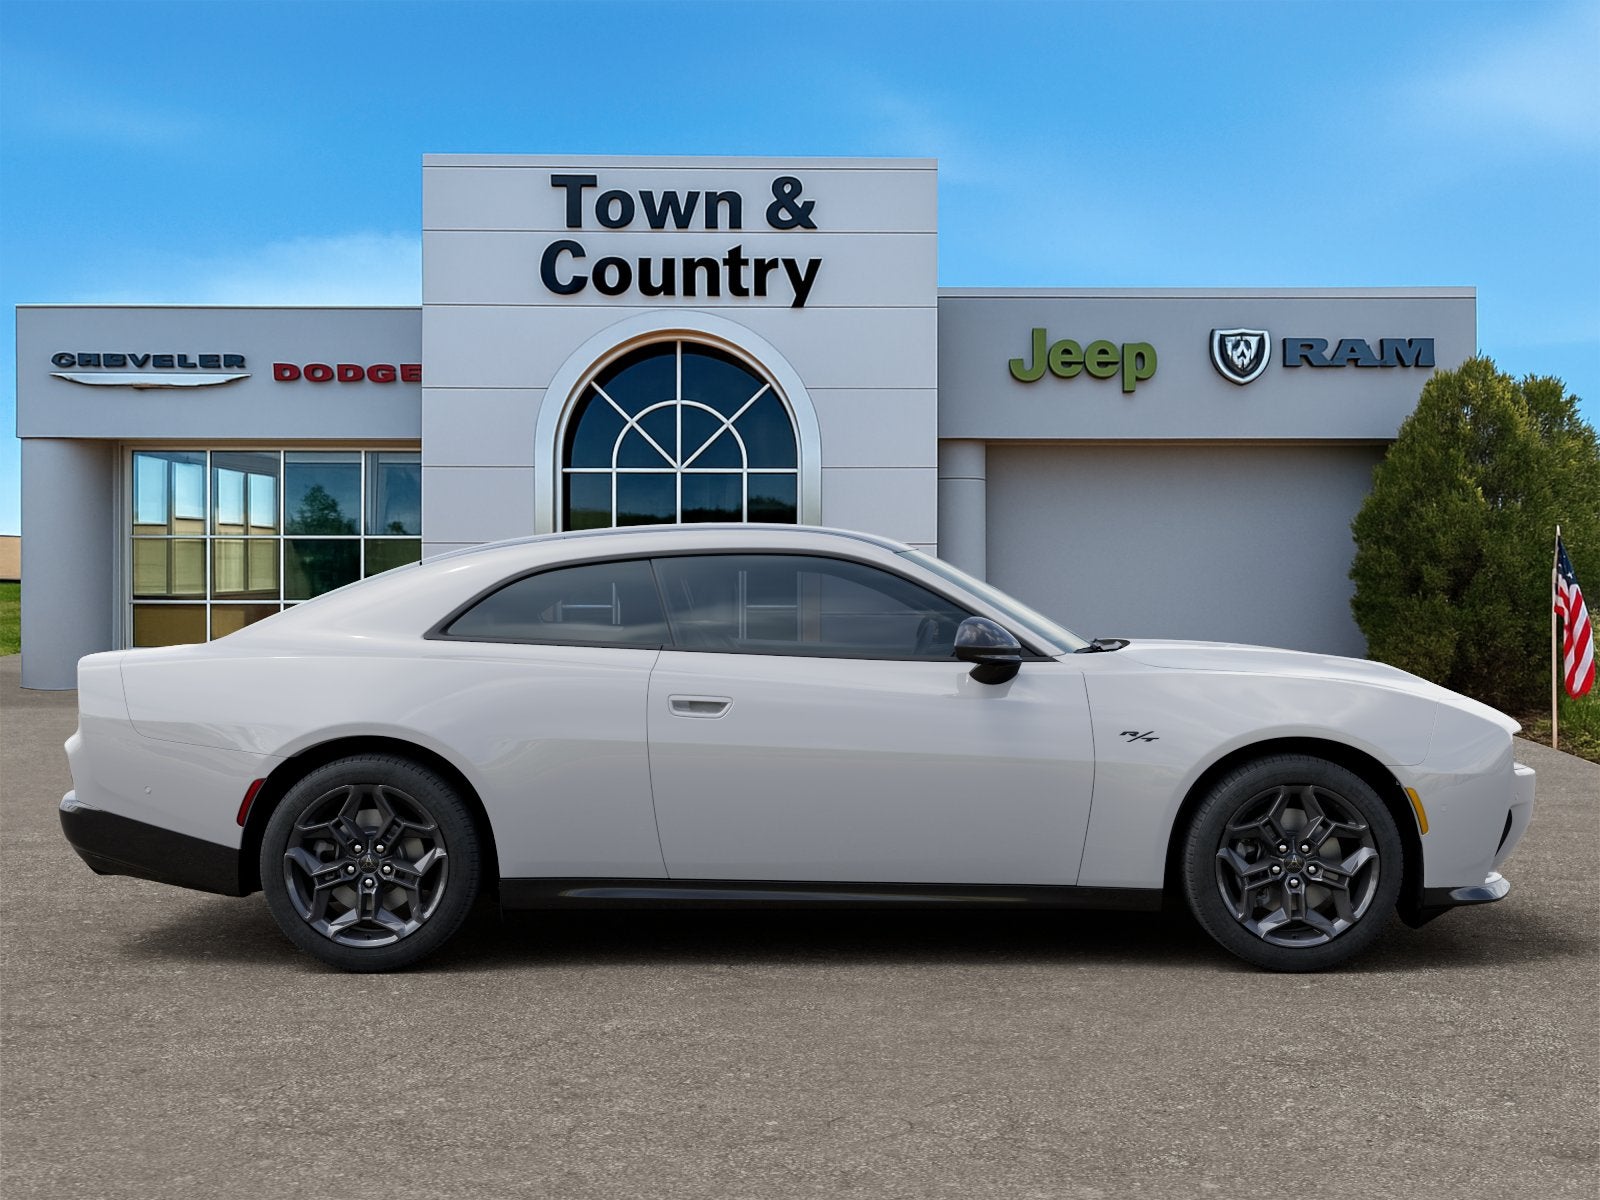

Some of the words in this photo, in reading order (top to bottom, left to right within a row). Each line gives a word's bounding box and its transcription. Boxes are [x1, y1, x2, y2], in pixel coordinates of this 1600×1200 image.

[551, 174, 742, 230] Town
[766, 176, 818, 230] &
[540, 239, 822, 308] Country
[273, 362, 422, 383] DODGE
[1009, 328, 1158, 393] Jeep
[1282, 337, 1436, 368] RAM
